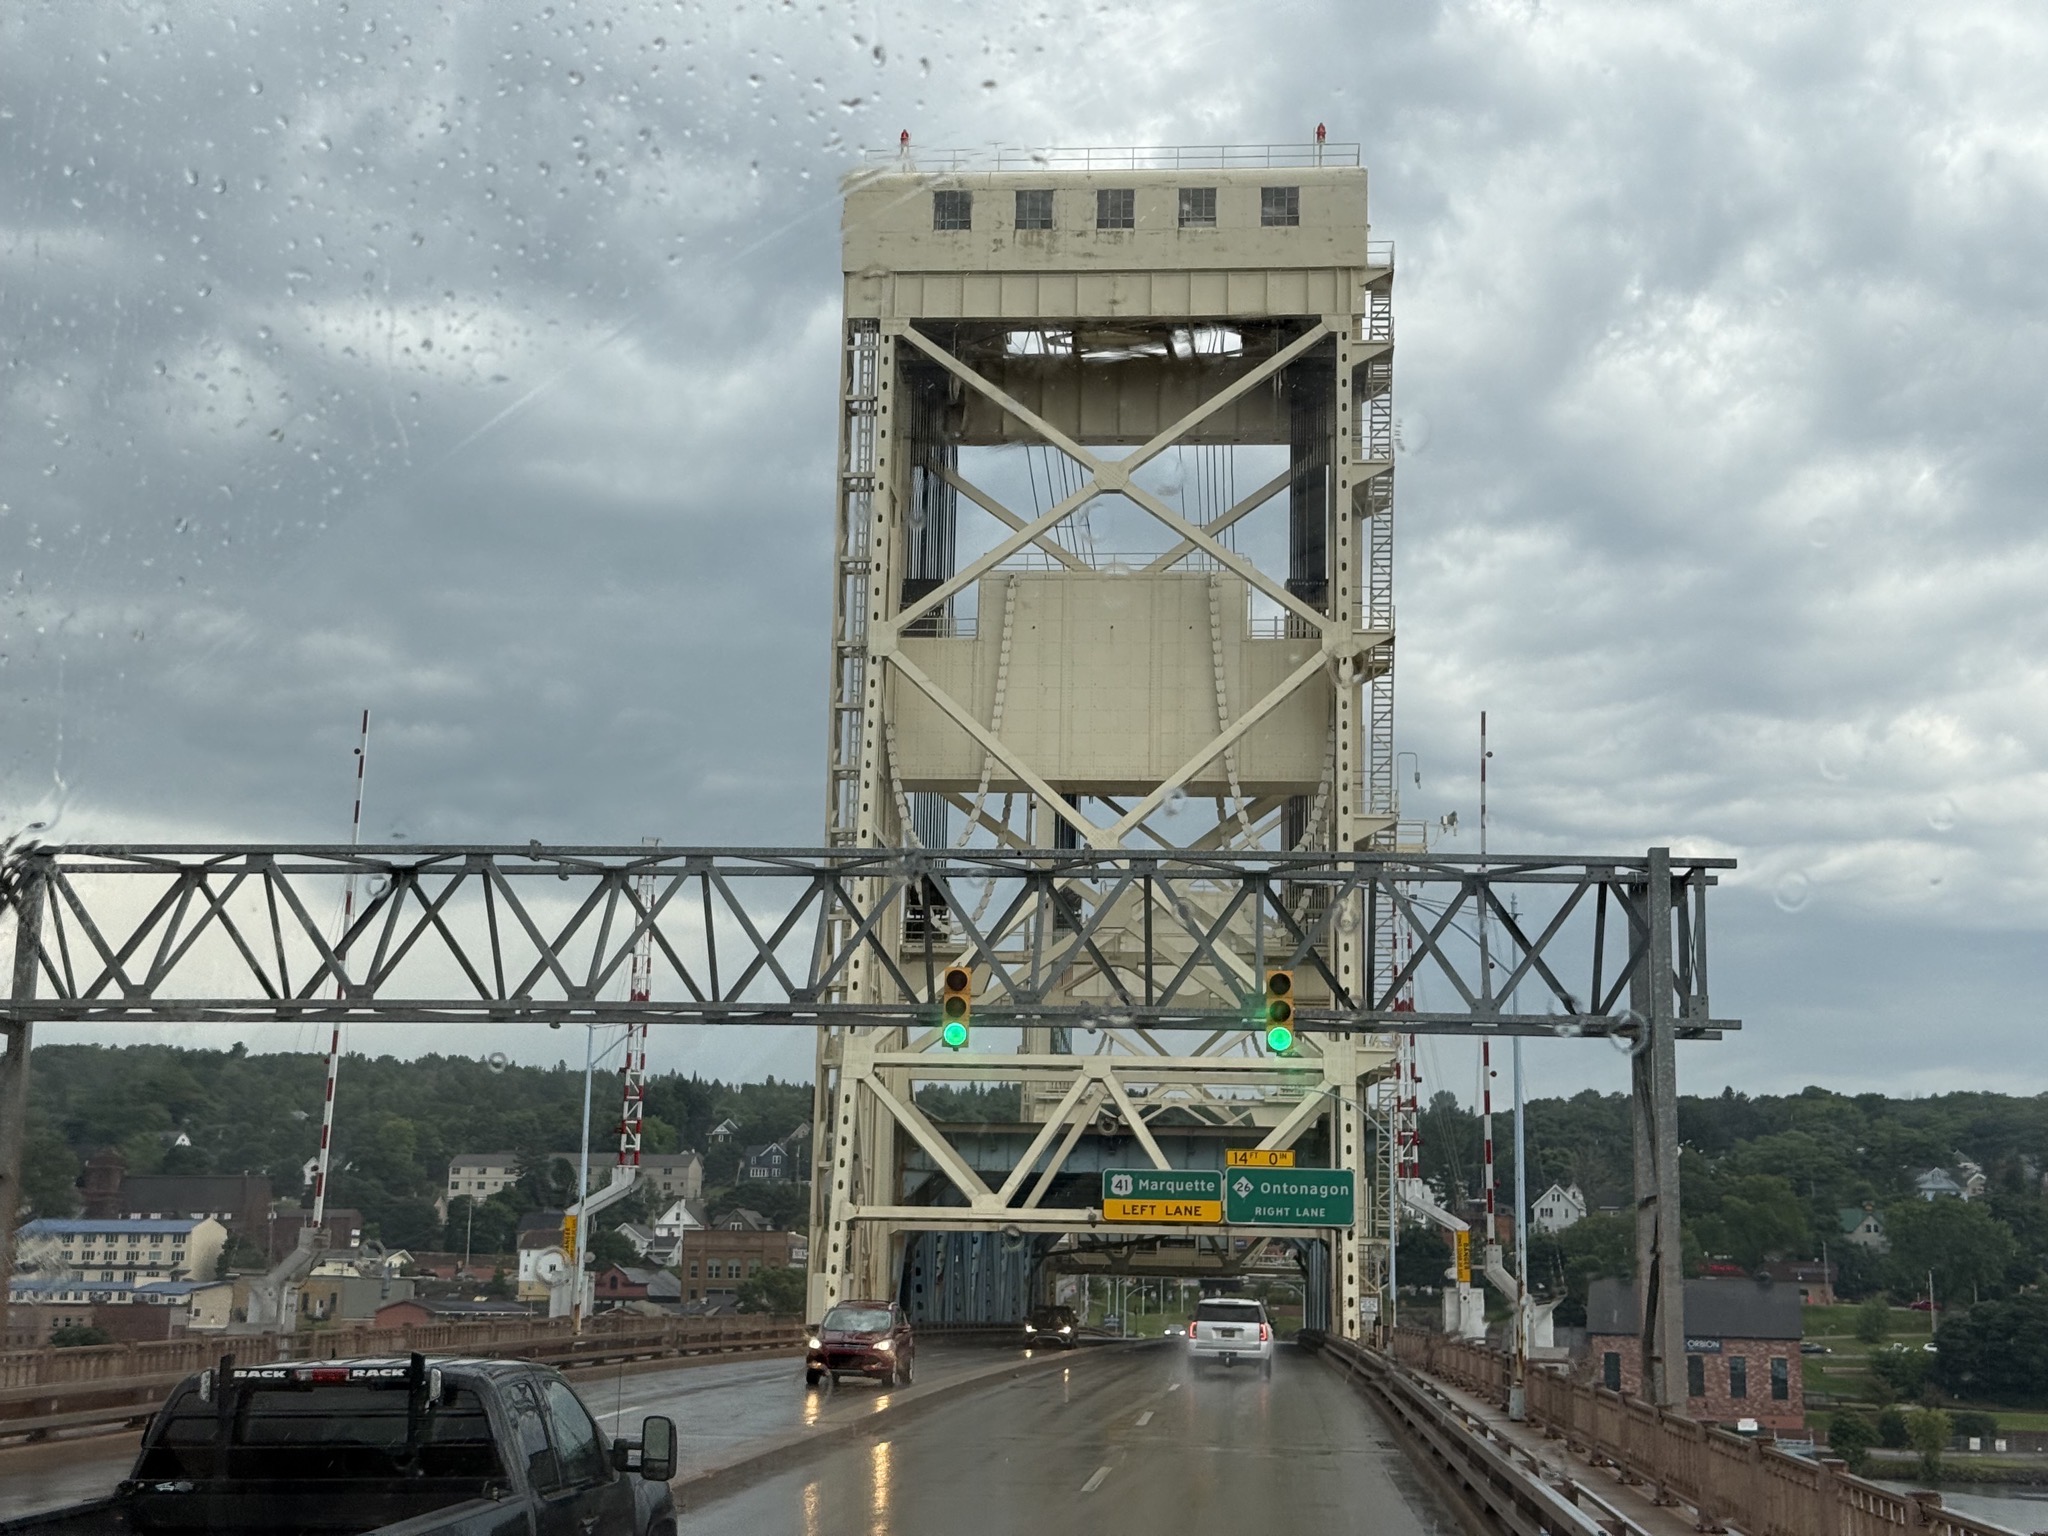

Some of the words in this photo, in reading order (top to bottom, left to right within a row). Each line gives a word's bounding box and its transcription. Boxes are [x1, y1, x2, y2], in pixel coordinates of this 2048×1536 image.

[1233, 1152, 1248, 1165] 14
[1268, 1152, 1278, 1166] 0
[1279, 1152, 1287, 1160] IN
[1114, 1179, 1128, 1192] 41
[1138, 1179, 1215, 1194] Marquette
[1236, 1181, 1251, 1193] 26
[1260, 1182, 1349, 1199] Ontonagon
[1122, 1204, 1157, 1216] LEFT
[1165, 1205, 1203, 1217] LANE
[1254, 1206, 1291, 1217] RIGHT
[1295, 1207, 1326, 1217] LANE
[233, 1370, 287, 1378] BACK
[352, 1369, 406, 1377] RACK
